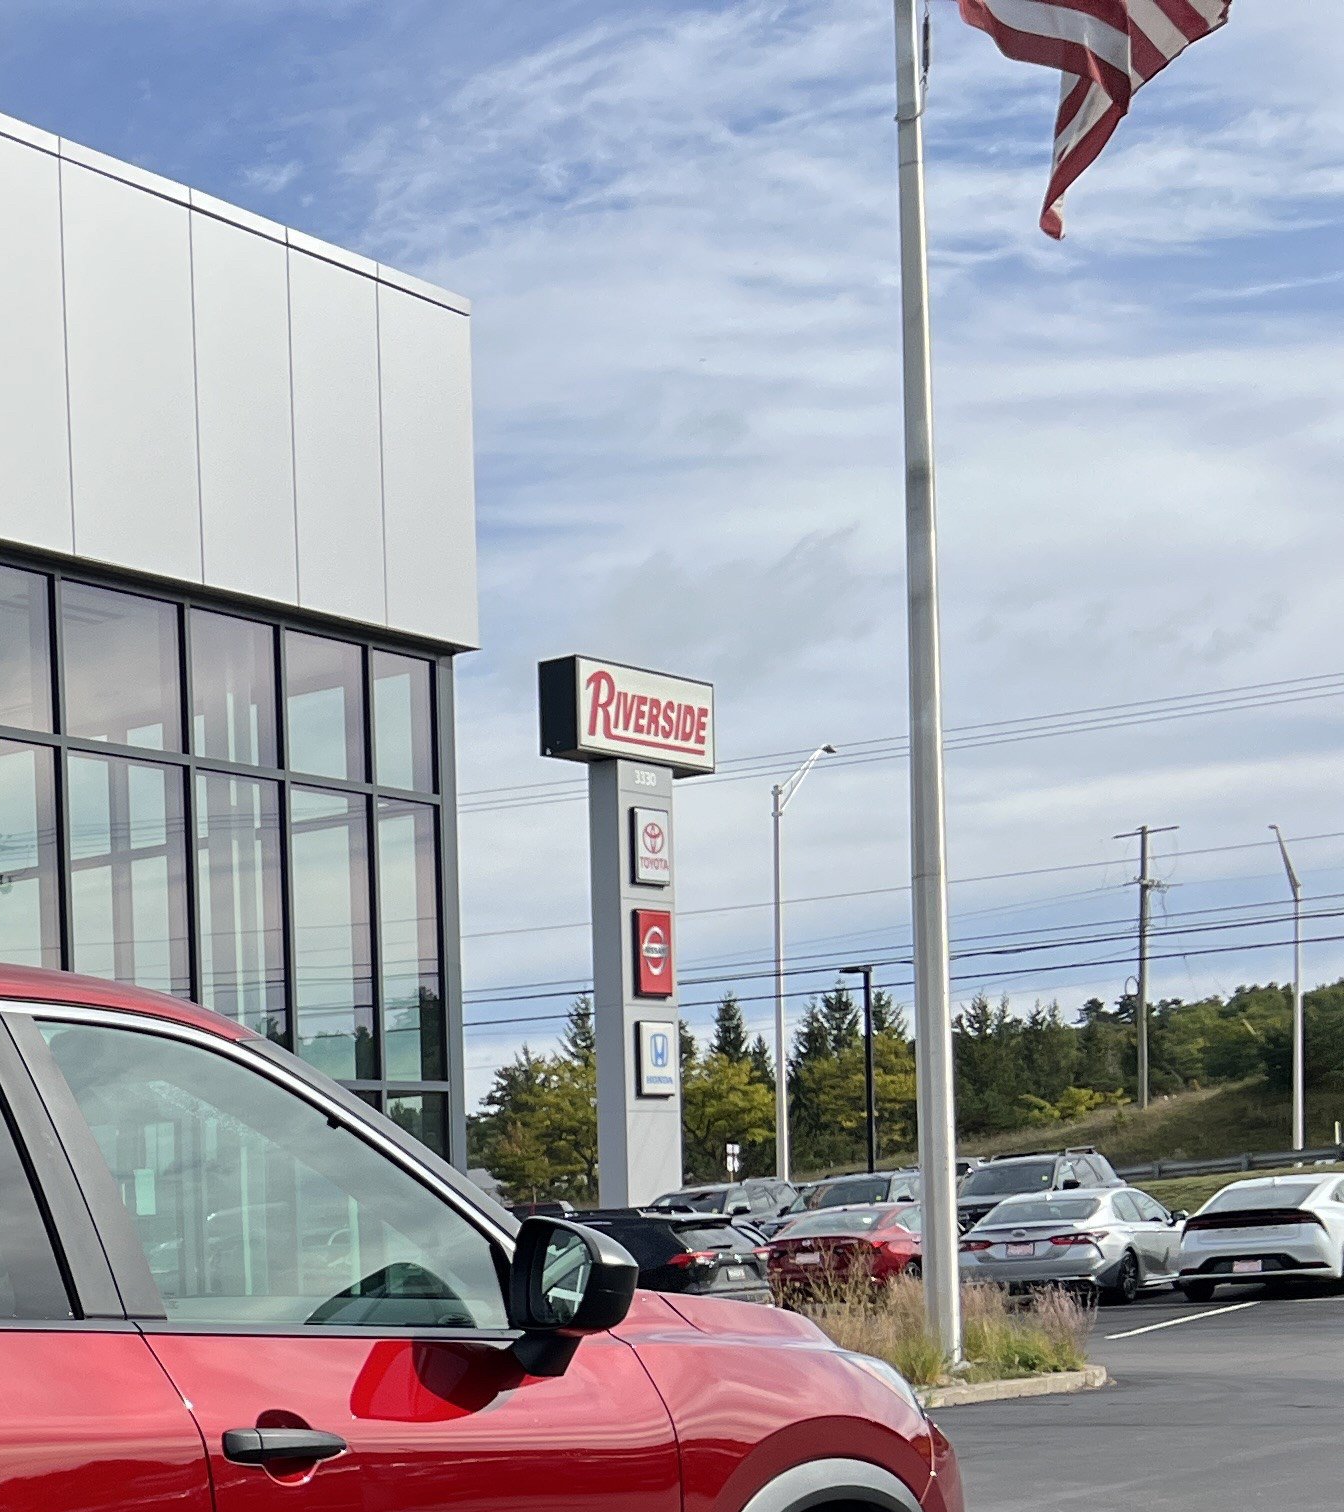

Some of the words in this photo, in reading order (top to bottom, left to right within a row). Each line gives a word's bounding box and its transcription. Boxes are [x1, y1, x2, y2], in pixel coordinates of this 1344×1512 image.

[585, 670, 710, 746] RIVERSIDE
[634, 769, 657, 787] 3330
[639, 856, 670, 871] TOYOTA
[646, 1075, 673, 1085] HONDA
